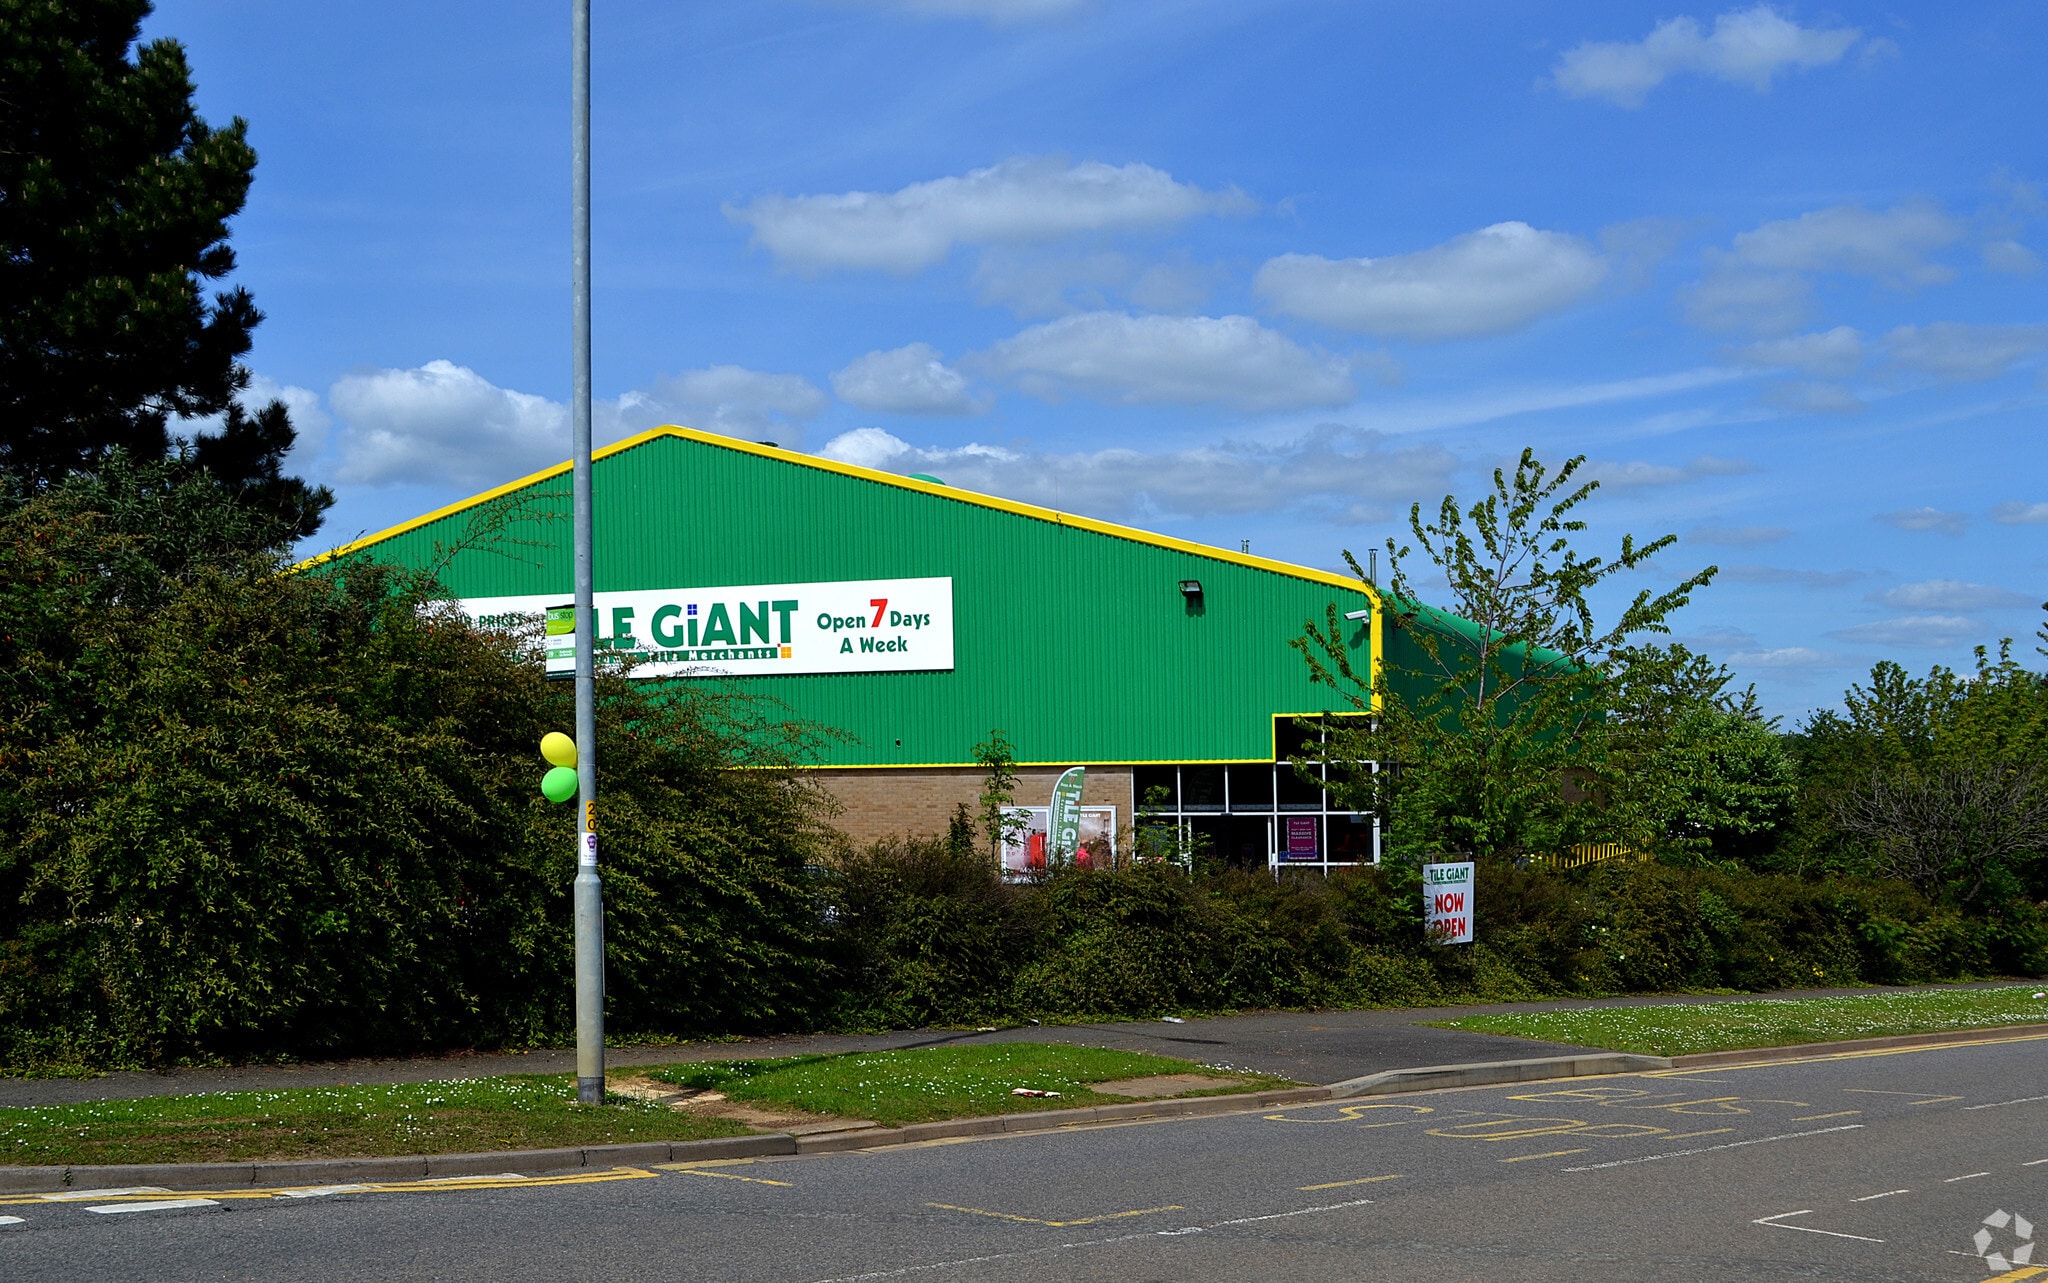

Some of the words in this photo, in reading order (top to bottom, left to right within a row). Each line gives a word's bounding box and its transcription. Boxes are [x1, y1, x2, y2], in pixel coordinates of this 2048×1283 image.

[547, 610, 559, 621] bus
[560, 611, 573, 622] stop
[816, 612, 866, 633] Open
[870, 598, 888, 628] 7
[890, 610, 930, 630] Days
[839, 637, 854, 654] A
[859, 635, 908, 653] Week
[689, 649, 772, 661] Merchants
[1435, 892, 1464, 914] NOW
